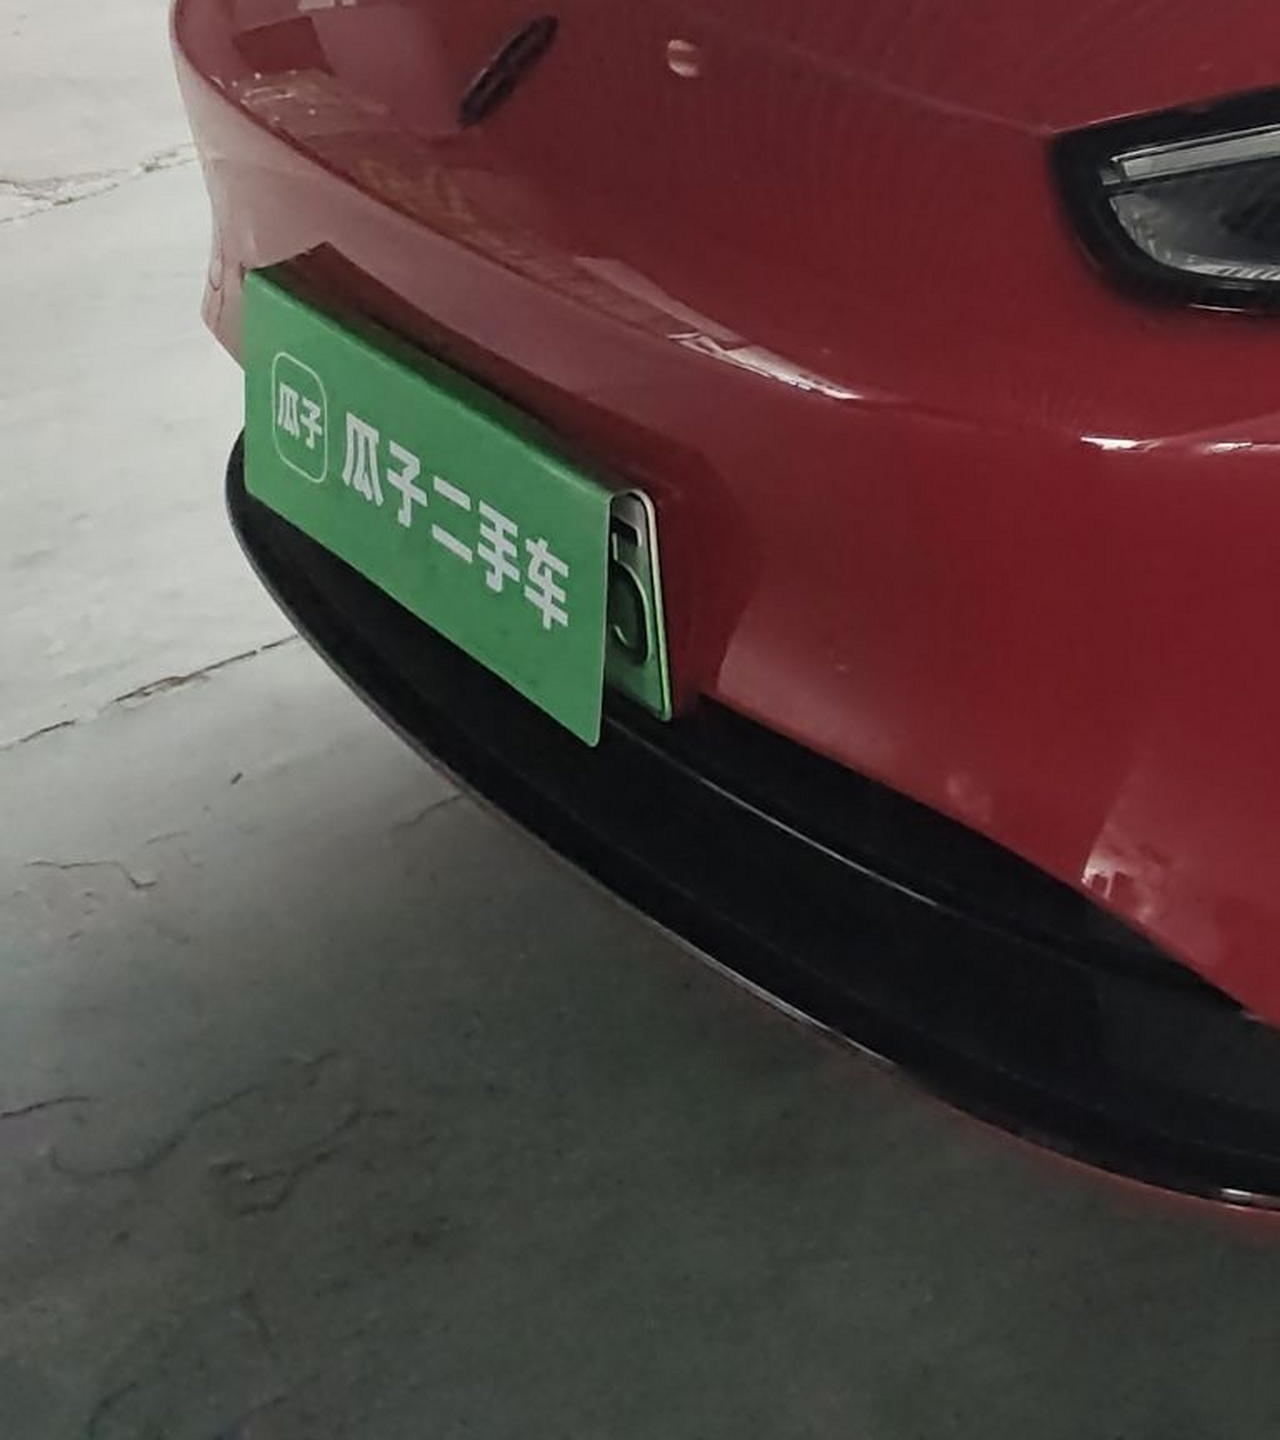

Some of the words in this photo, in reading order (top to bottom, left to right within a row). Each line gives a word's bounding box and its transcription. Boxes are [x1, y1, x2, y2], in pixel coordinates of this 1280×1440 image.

[278, 383, 323, 449] 瓜子
[342, 411, 569, 630] 瓜子二手车
